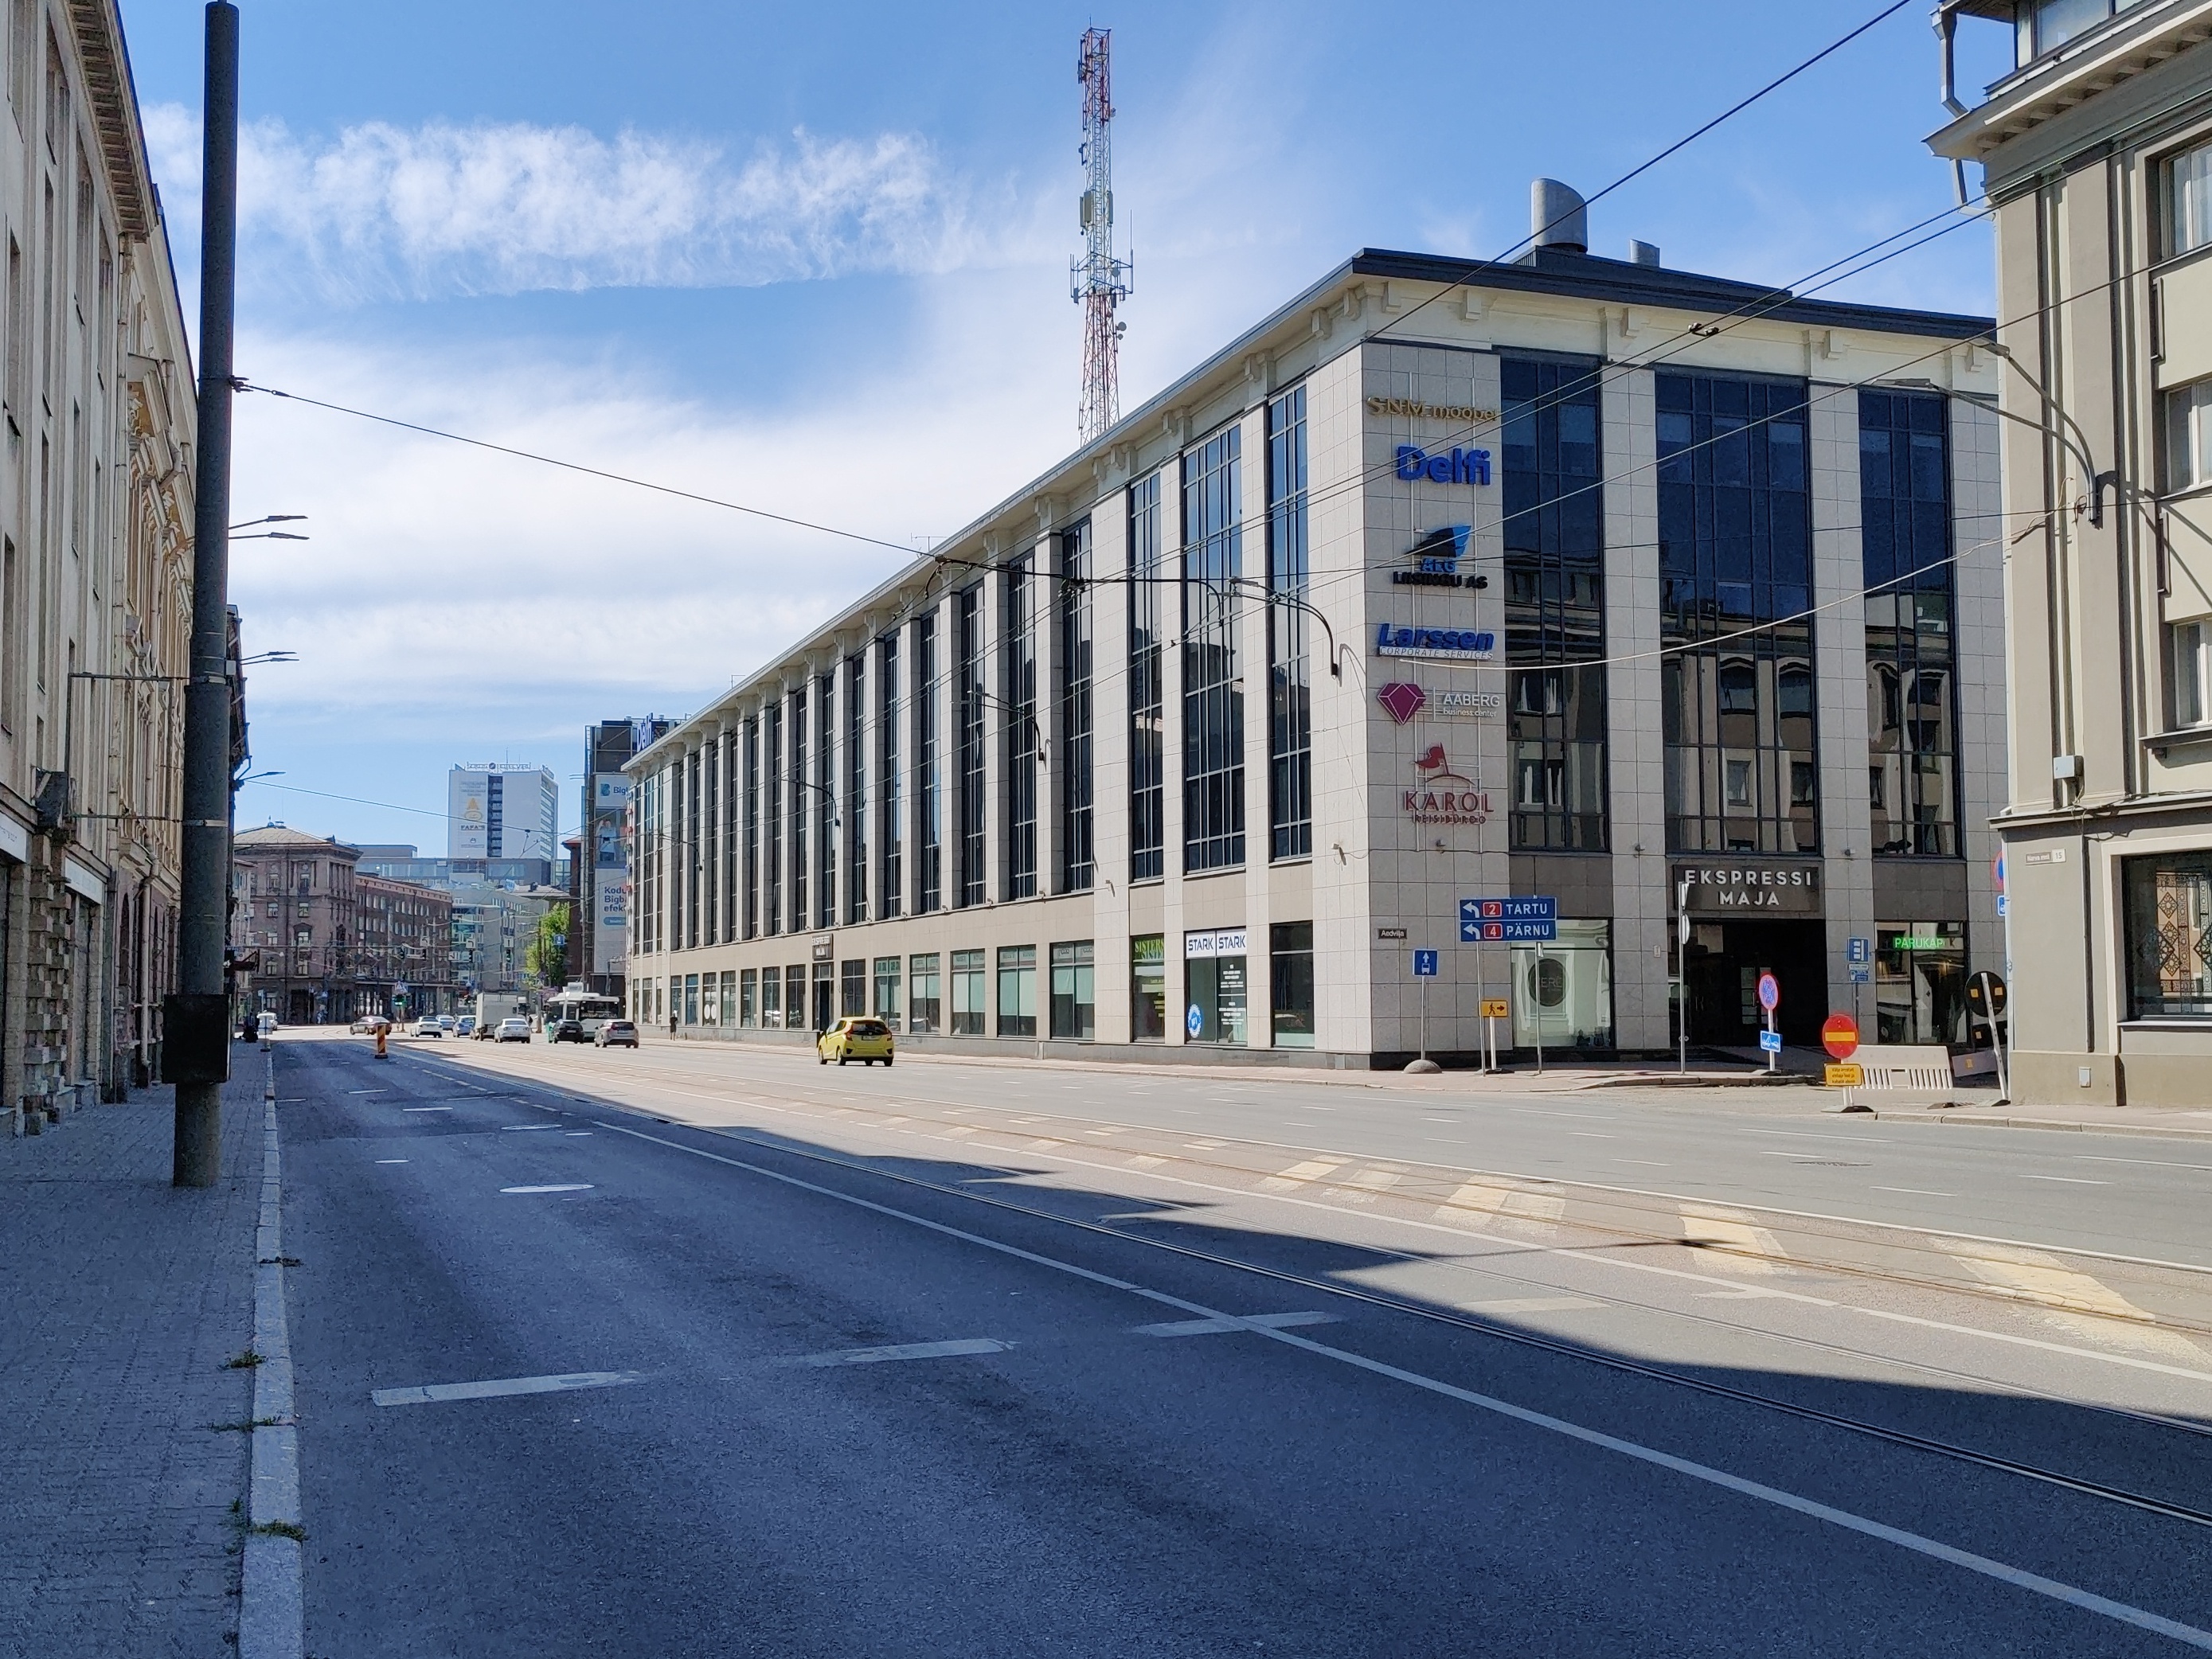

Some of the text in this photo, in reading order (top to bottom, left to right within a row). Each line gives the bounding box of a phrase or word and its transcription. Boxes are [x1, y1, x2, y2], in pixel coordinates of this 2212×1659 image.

[1398, 446, 1491, 485] Delfi
[1466, 576, 1487, 589] AS
[1378, 623, 1495, 650] Larssen
[1379, 646, 1494, 660] CORPORATE SERVICES
[1443, 693, 1500, 707] AABERG
[1443, 707, 1473, 716] business
[1405, 790, 1494, 813] KAROL
[1684, 869, 1811, 886] EKSPRESSI
[1718, 891, 1780, 906] MAJA
[1488, 903, 1548, 915] 2 TARTU
[1490, 922, 1550, 937] 4 PÄRNU
[1188, 935, 1246, 951] STARK STARK
[1894, 937, 1945, 948] PARUKAP
